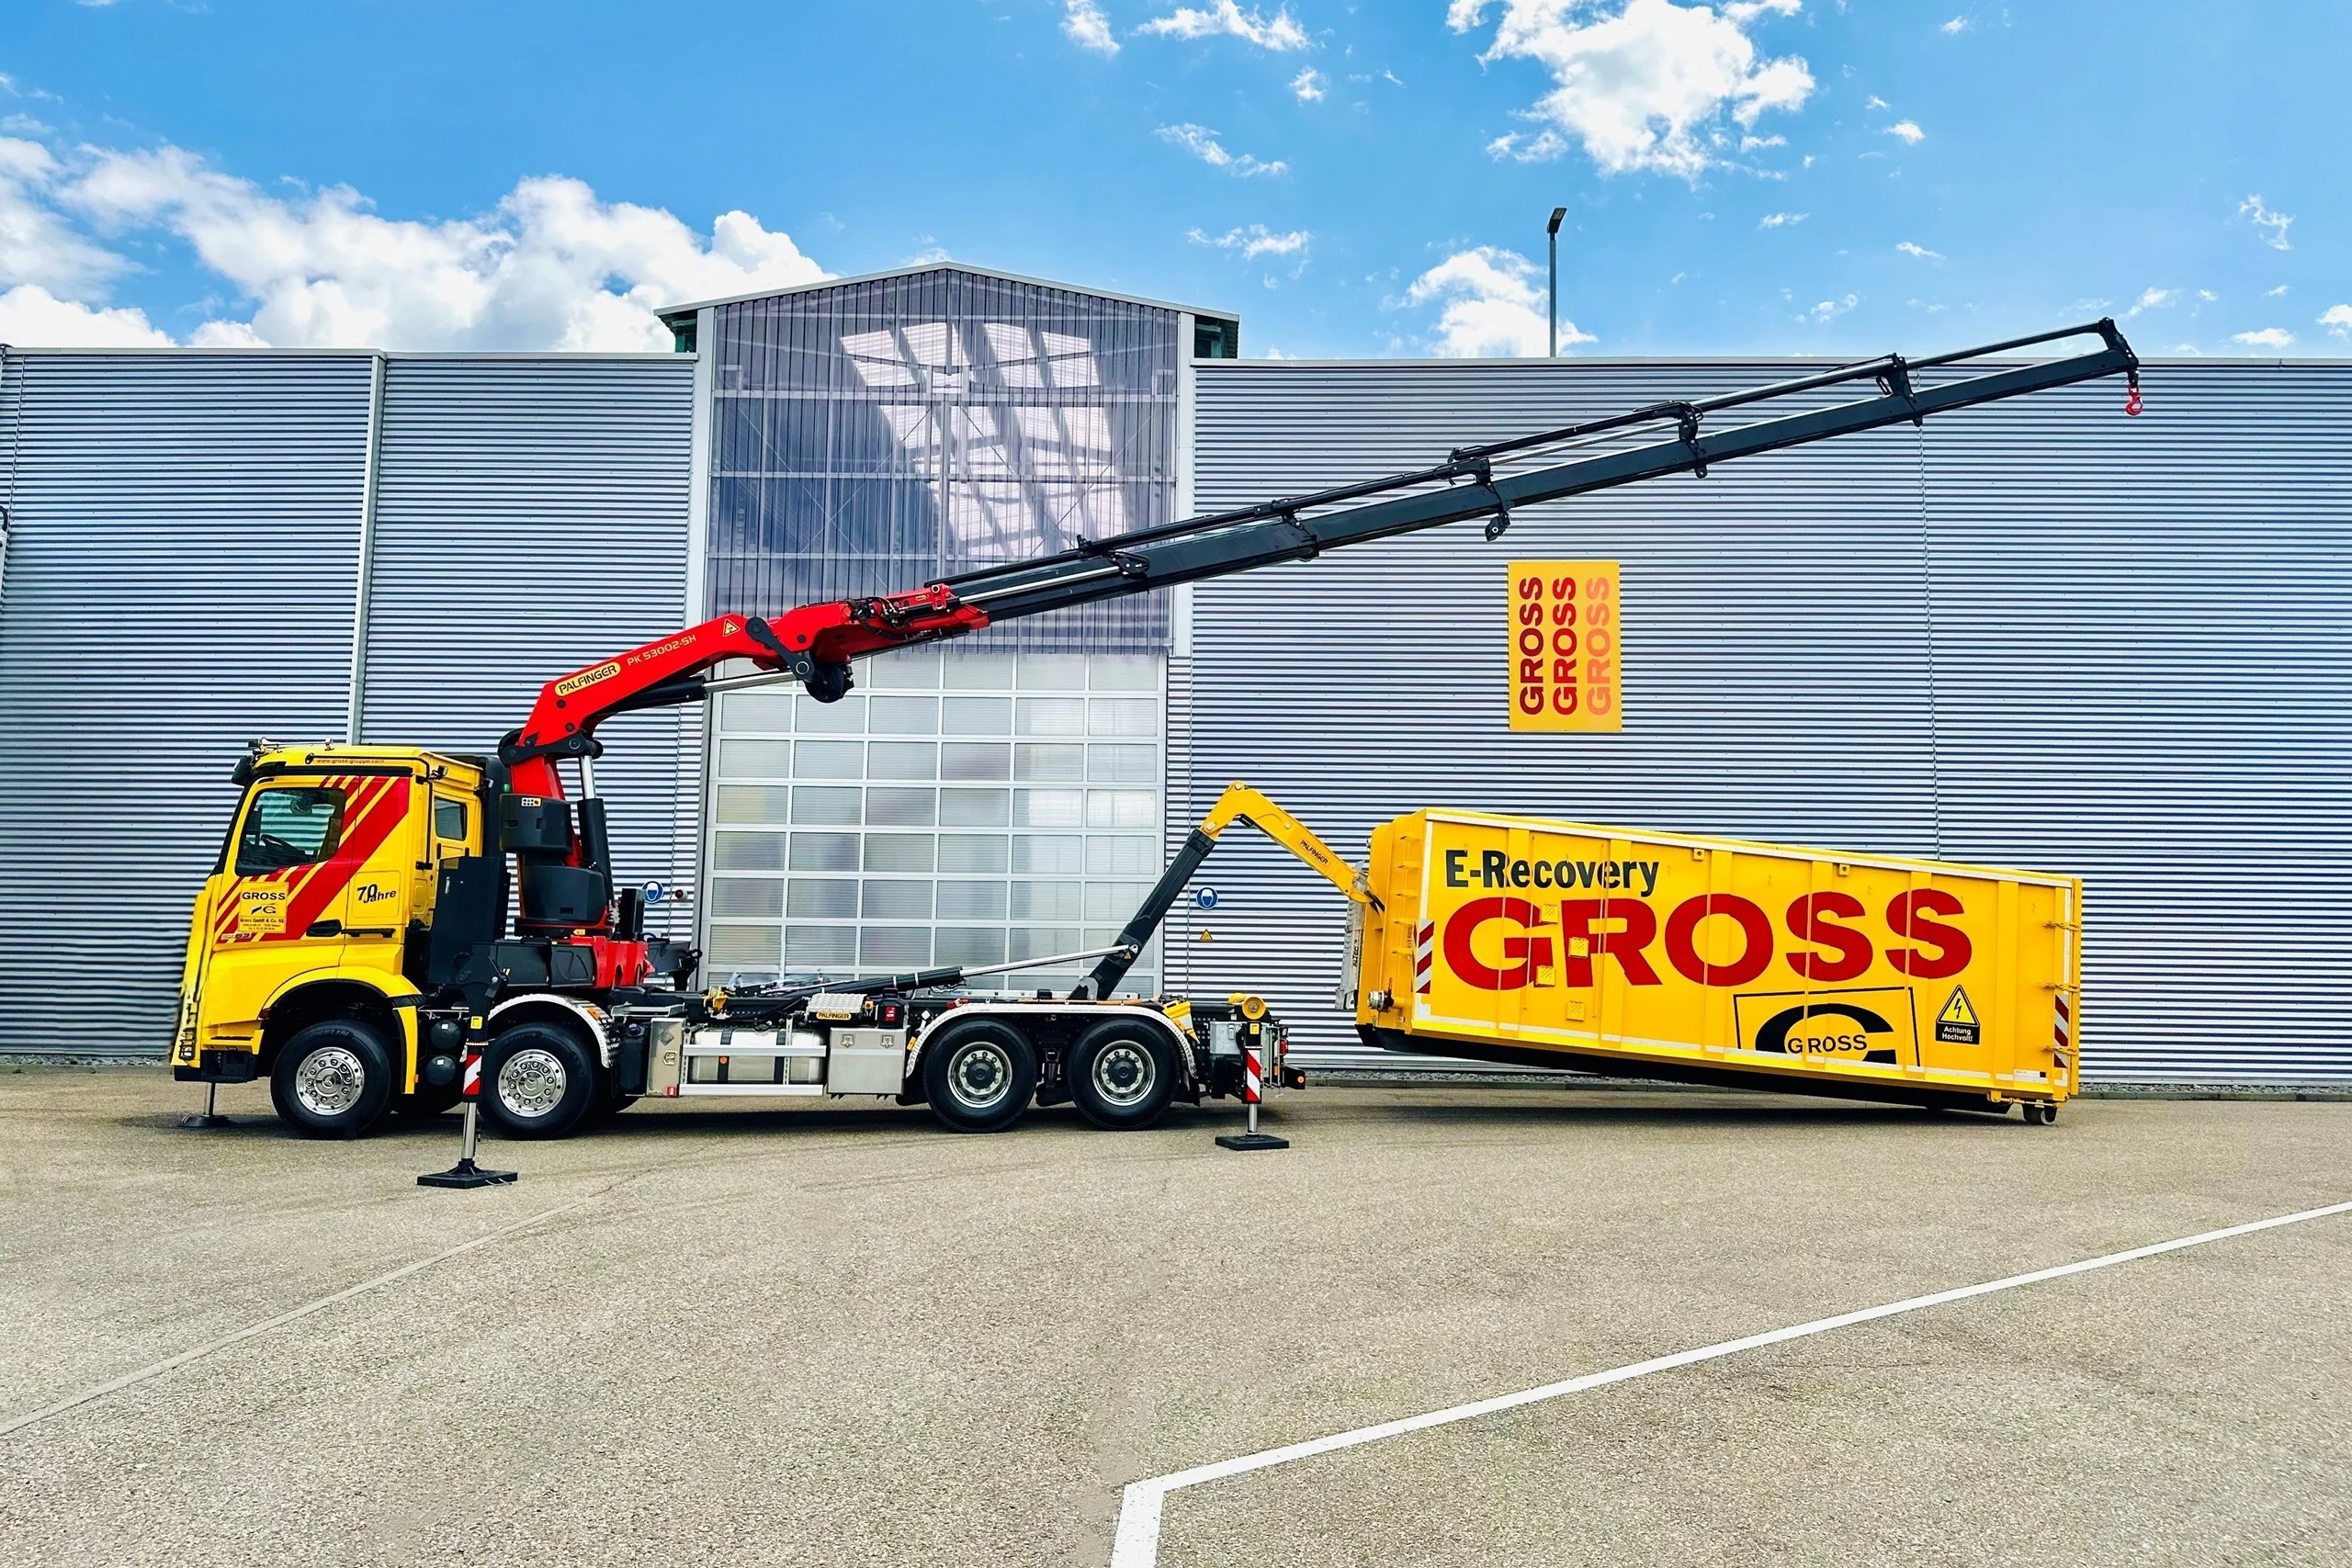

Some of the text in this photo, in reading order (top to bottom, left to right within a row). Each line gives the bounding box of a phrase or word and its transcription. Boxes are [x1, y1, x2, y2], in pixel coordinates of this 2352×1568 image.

[627, 634, 697, 667] PK 53002-SH
[1519, 577, 1544, 716] GROSS
[1553, 577, 1577, 716] GROSS
[1586, 577, 1611, 716] GROSS
[559, 664, 617, 694] PALFINGER
[1299, 840, 1329, 865] PALFINGER
[1446, 849, 1659, 897] E-Recovery
[242, 892, 286, 900] GROSS
[363, 890, 397, 904] Jahre
[1443, 888, 1973, 991] GROSS
[1787, 1034, 1869, 1055] GROSS
[1943, 1025, 1972, 1036] Achtung
